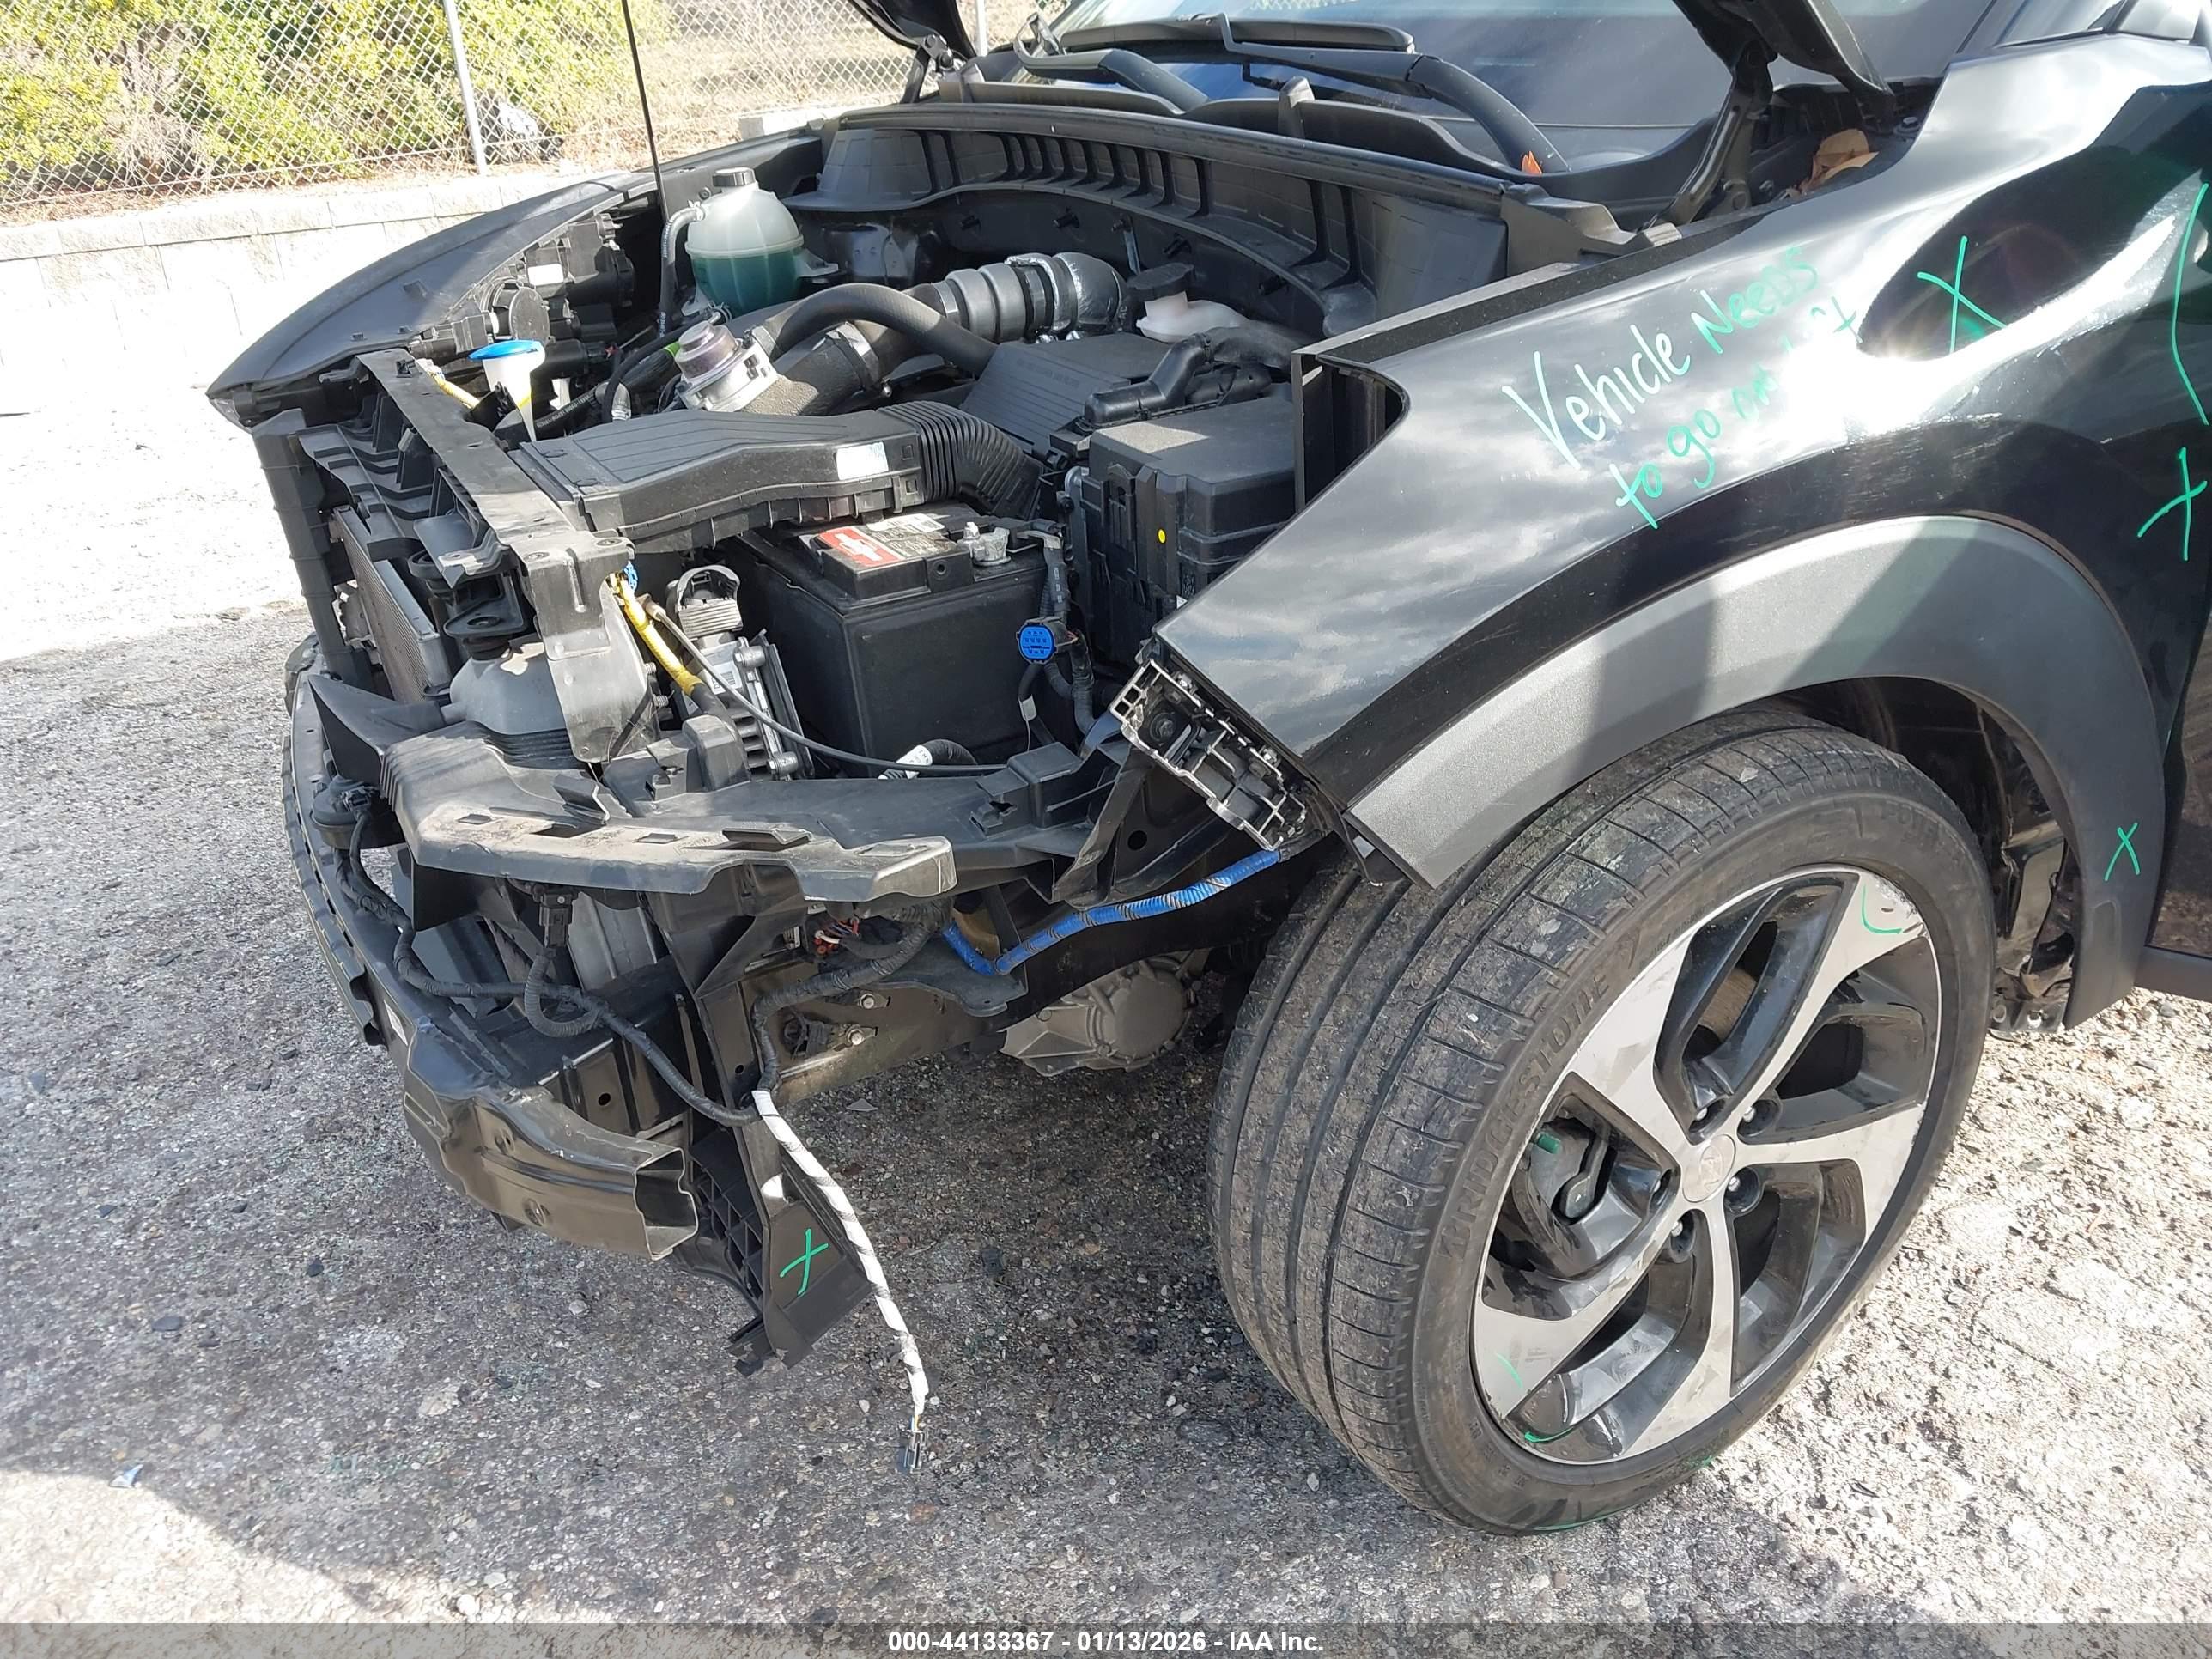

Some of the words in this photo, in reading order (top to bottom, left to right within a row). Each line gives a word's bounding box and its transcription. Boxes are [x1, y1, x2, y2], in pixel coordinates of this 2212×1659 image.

[1501, 324, 1691, 470] Vehicle
[1608, 463, 1663, 530] to
[1667, 408, 1722, 489] go
